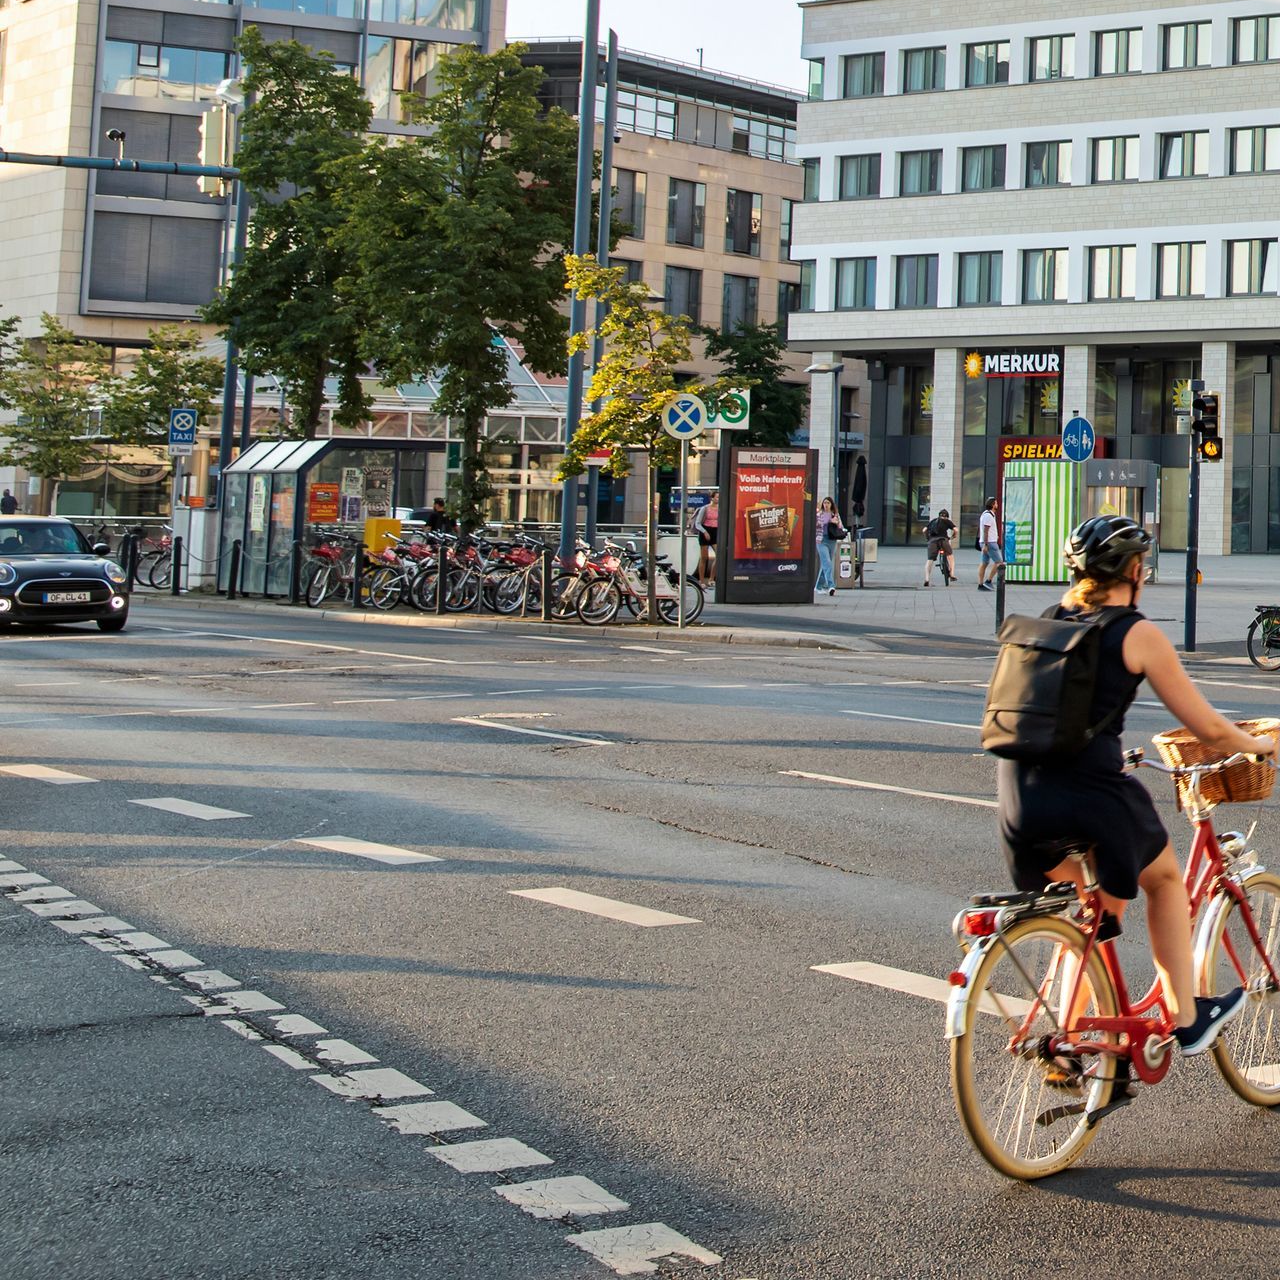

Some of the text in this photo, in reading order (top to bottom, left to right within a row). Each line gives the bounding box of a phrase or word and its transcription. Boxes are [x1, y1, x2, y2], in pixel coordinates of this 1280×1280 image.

[984, 354, 1060, 372] MERKUR
[172, 432, 192, 440] TAXI
[750, 453, 792, 463] Marktplatz
[938, 462, 945, 470] 50
[740, 475, 802, 484] Volle Haferkraft
[761, 508, 785, 518] Hafer
[759, 516, 779, 525] kraft
